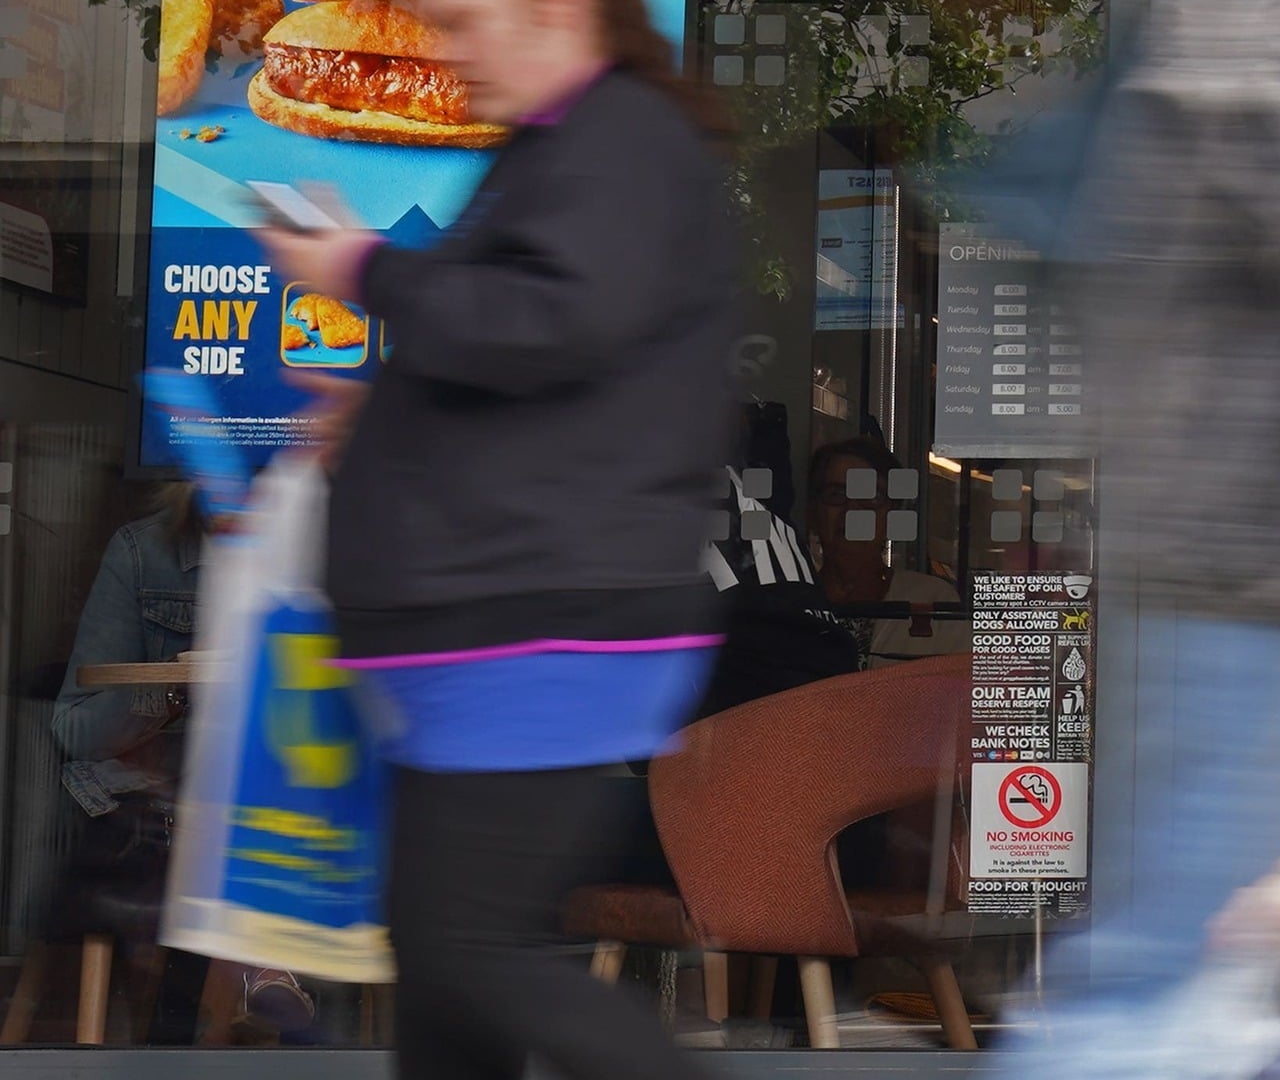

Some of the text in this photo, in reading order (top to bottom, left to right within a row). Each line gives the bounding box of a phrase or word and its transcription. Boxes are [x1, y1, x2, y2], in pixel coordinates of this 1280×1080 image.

[164, 264, 271, 294] CHOOSE
[173, 300, 258, 340] ANY
[183, 346, 245, 375] SIDE
[974, 576, 1062, 584] WE LIKE TO ENSURE
[974, 584, 1062, 592] THE SAFETY OF OUR
[973, 592, 1025, 600] CUSTOMERS
[973, 611, 1058, 619] ONLY ASSISTANCE
[973, 621, 1058, 629] DOGS ALLOWED
[972, 635, 1011, 645] GOOD
[1014, 635, 1051, 645] FOOD
[971, 687, 1050, 699] OUR TEAM
[971, 700, 1050, 708] DESERVE RESPECT
[985, 726, 1005, 736] WE
[1007, 726, 1049, 736] CHECK
[1058, 722, 1090, 732] KEEP
[971, 738, 1050, 748] BANK NOTES
[986, 831, 1074, 842] NO SMOKING
[968, 882, 1087, 891] FOOD FOR THOUGHT
